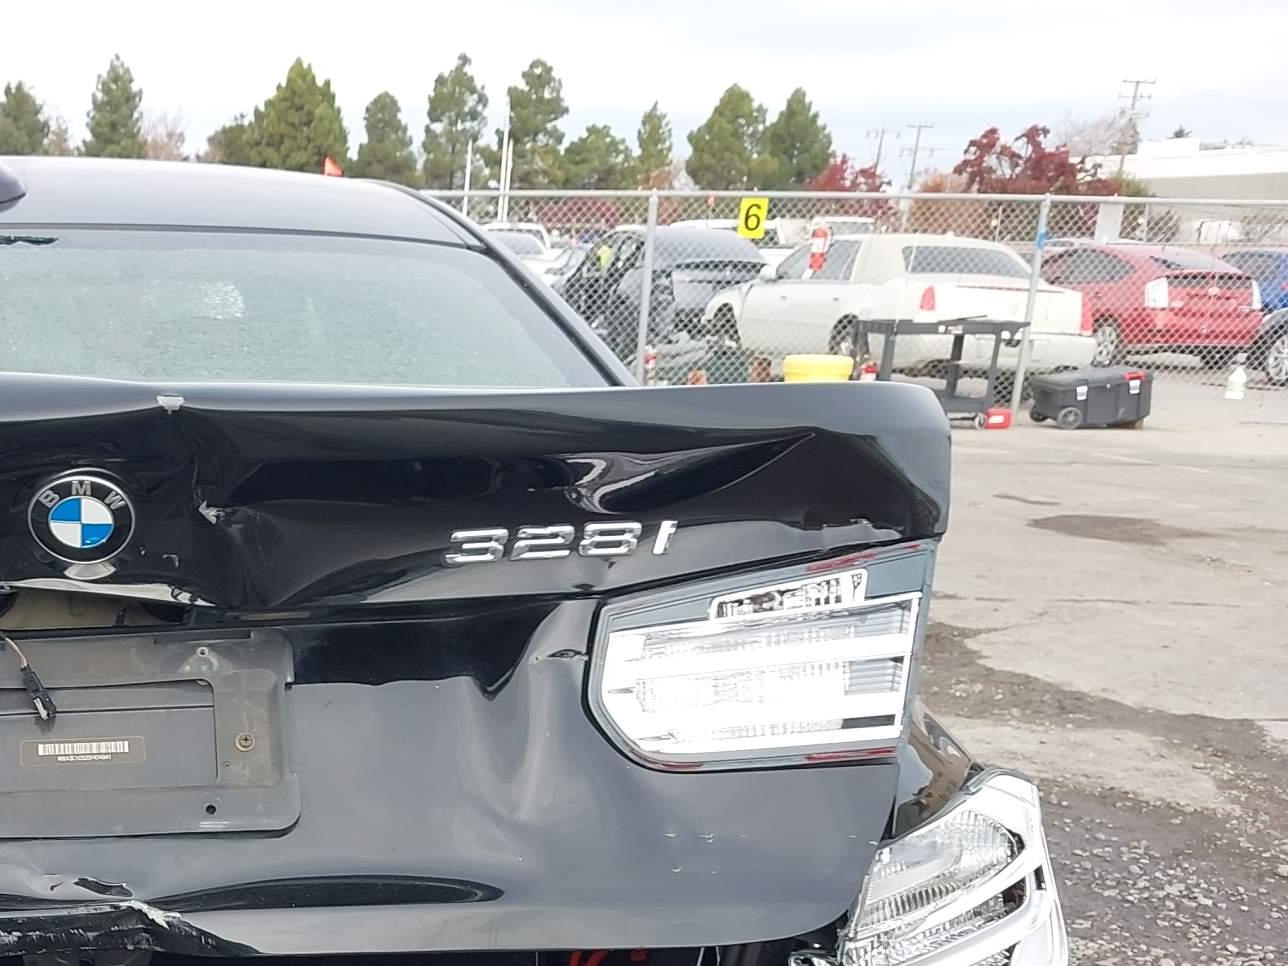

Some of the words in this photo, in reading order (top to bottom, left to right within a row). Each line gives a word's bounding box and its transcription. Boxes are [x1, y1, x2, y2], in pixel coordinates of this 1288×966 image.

[744, 203, 762, 231] 6
[38, 480, 126, 510] BMW
[443, 519, 679, 566] 328i
